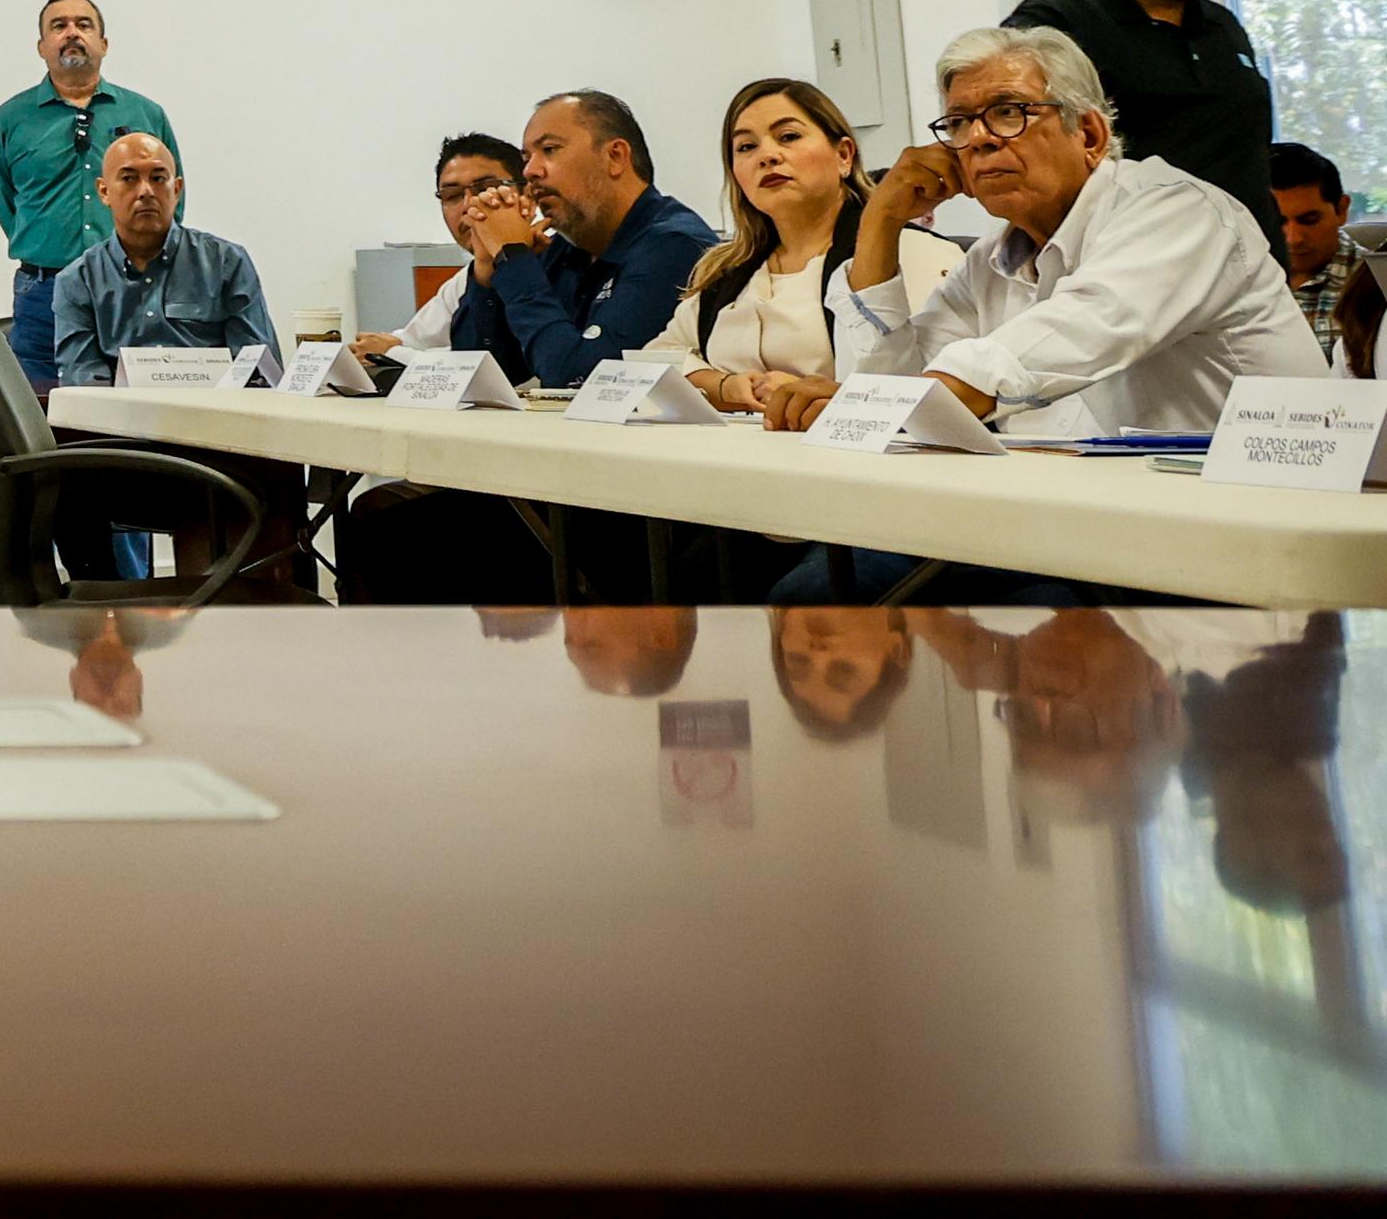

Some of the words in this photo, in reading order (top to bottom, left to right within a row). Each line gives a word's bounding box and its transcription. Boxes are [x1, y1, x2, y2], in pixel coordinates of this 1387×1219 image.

[150, 372, 211, 382] CESAVESIN
[1237, 409, 1275, 421] SINALOA
[1243, 436, 1288, 452] COLPOS
[1289, 440, 1337, 455] CAMPOS
[1247, 449, 1324, 467] MONTECILLOS
